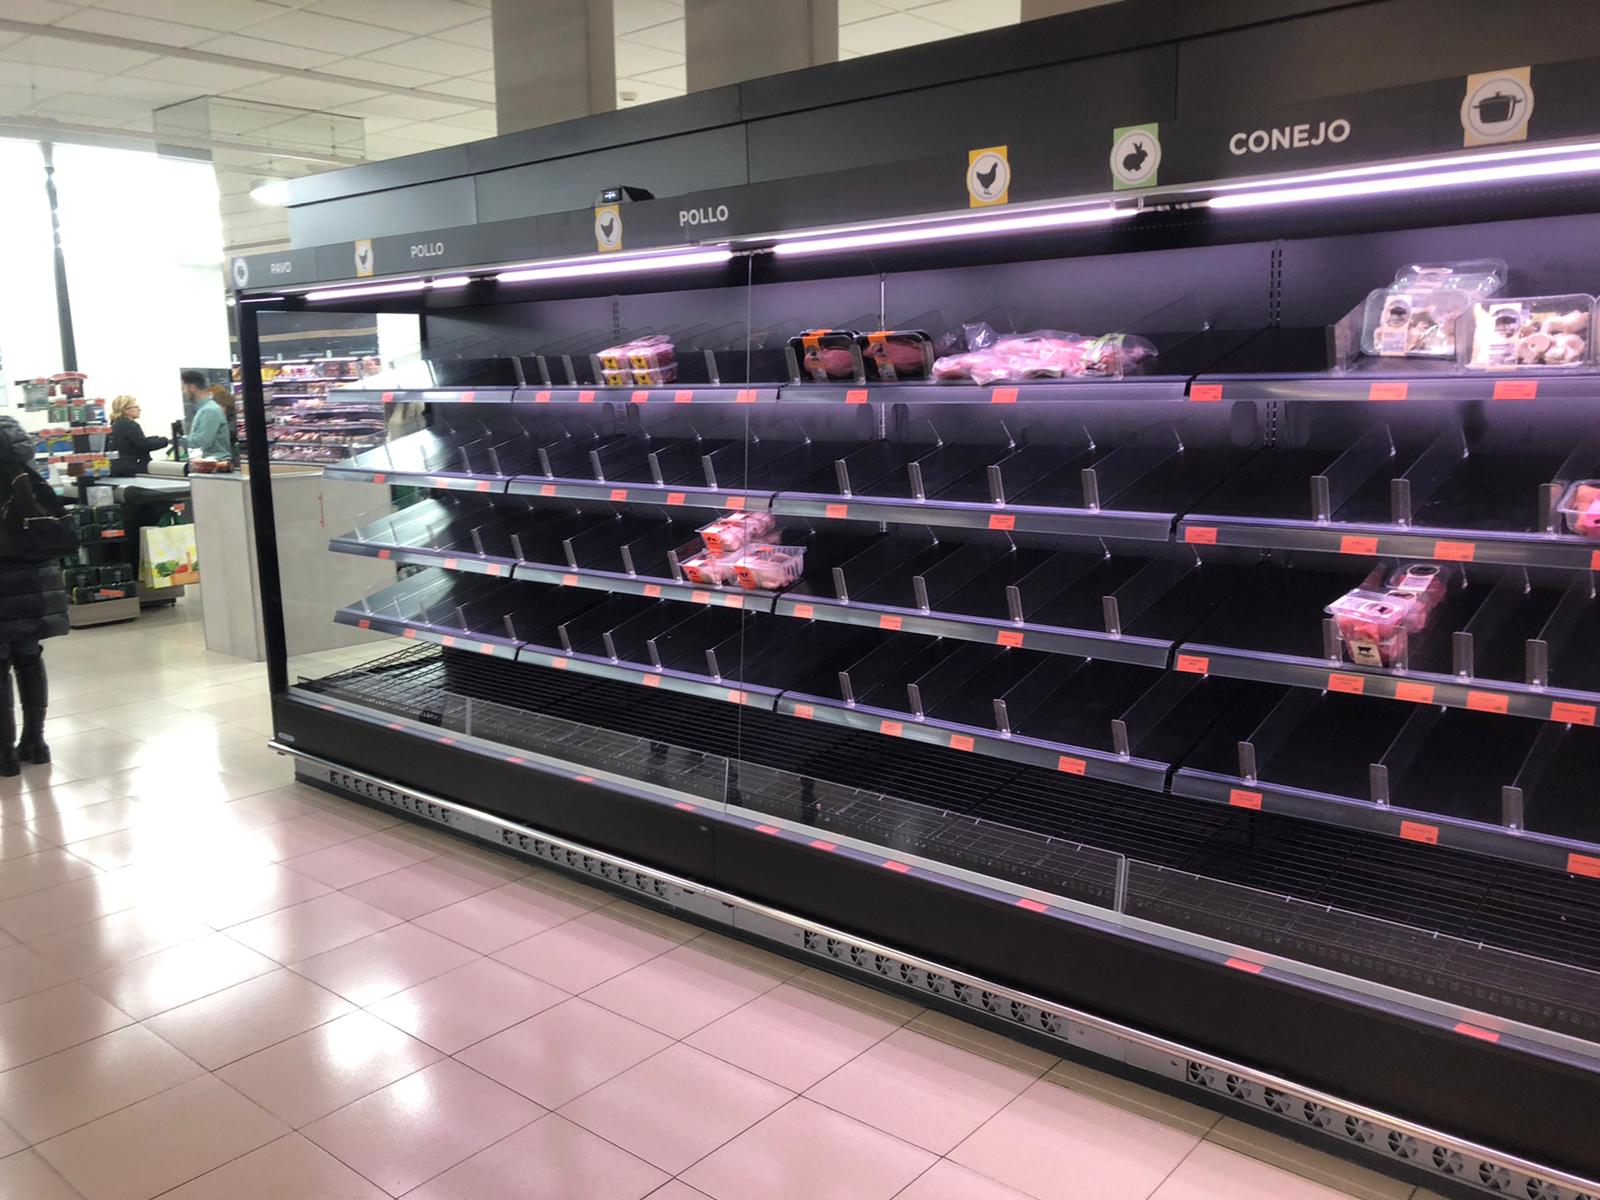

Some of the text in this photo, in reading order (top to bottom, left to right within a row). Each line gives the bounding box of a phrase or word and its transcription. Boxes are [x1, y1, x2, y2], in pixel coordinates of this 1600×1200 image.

[1229, 119, 1351, 155] CONEJO
[679, 205, 729, 227] POLLO
[411, 242, 444, 258] POLLO
